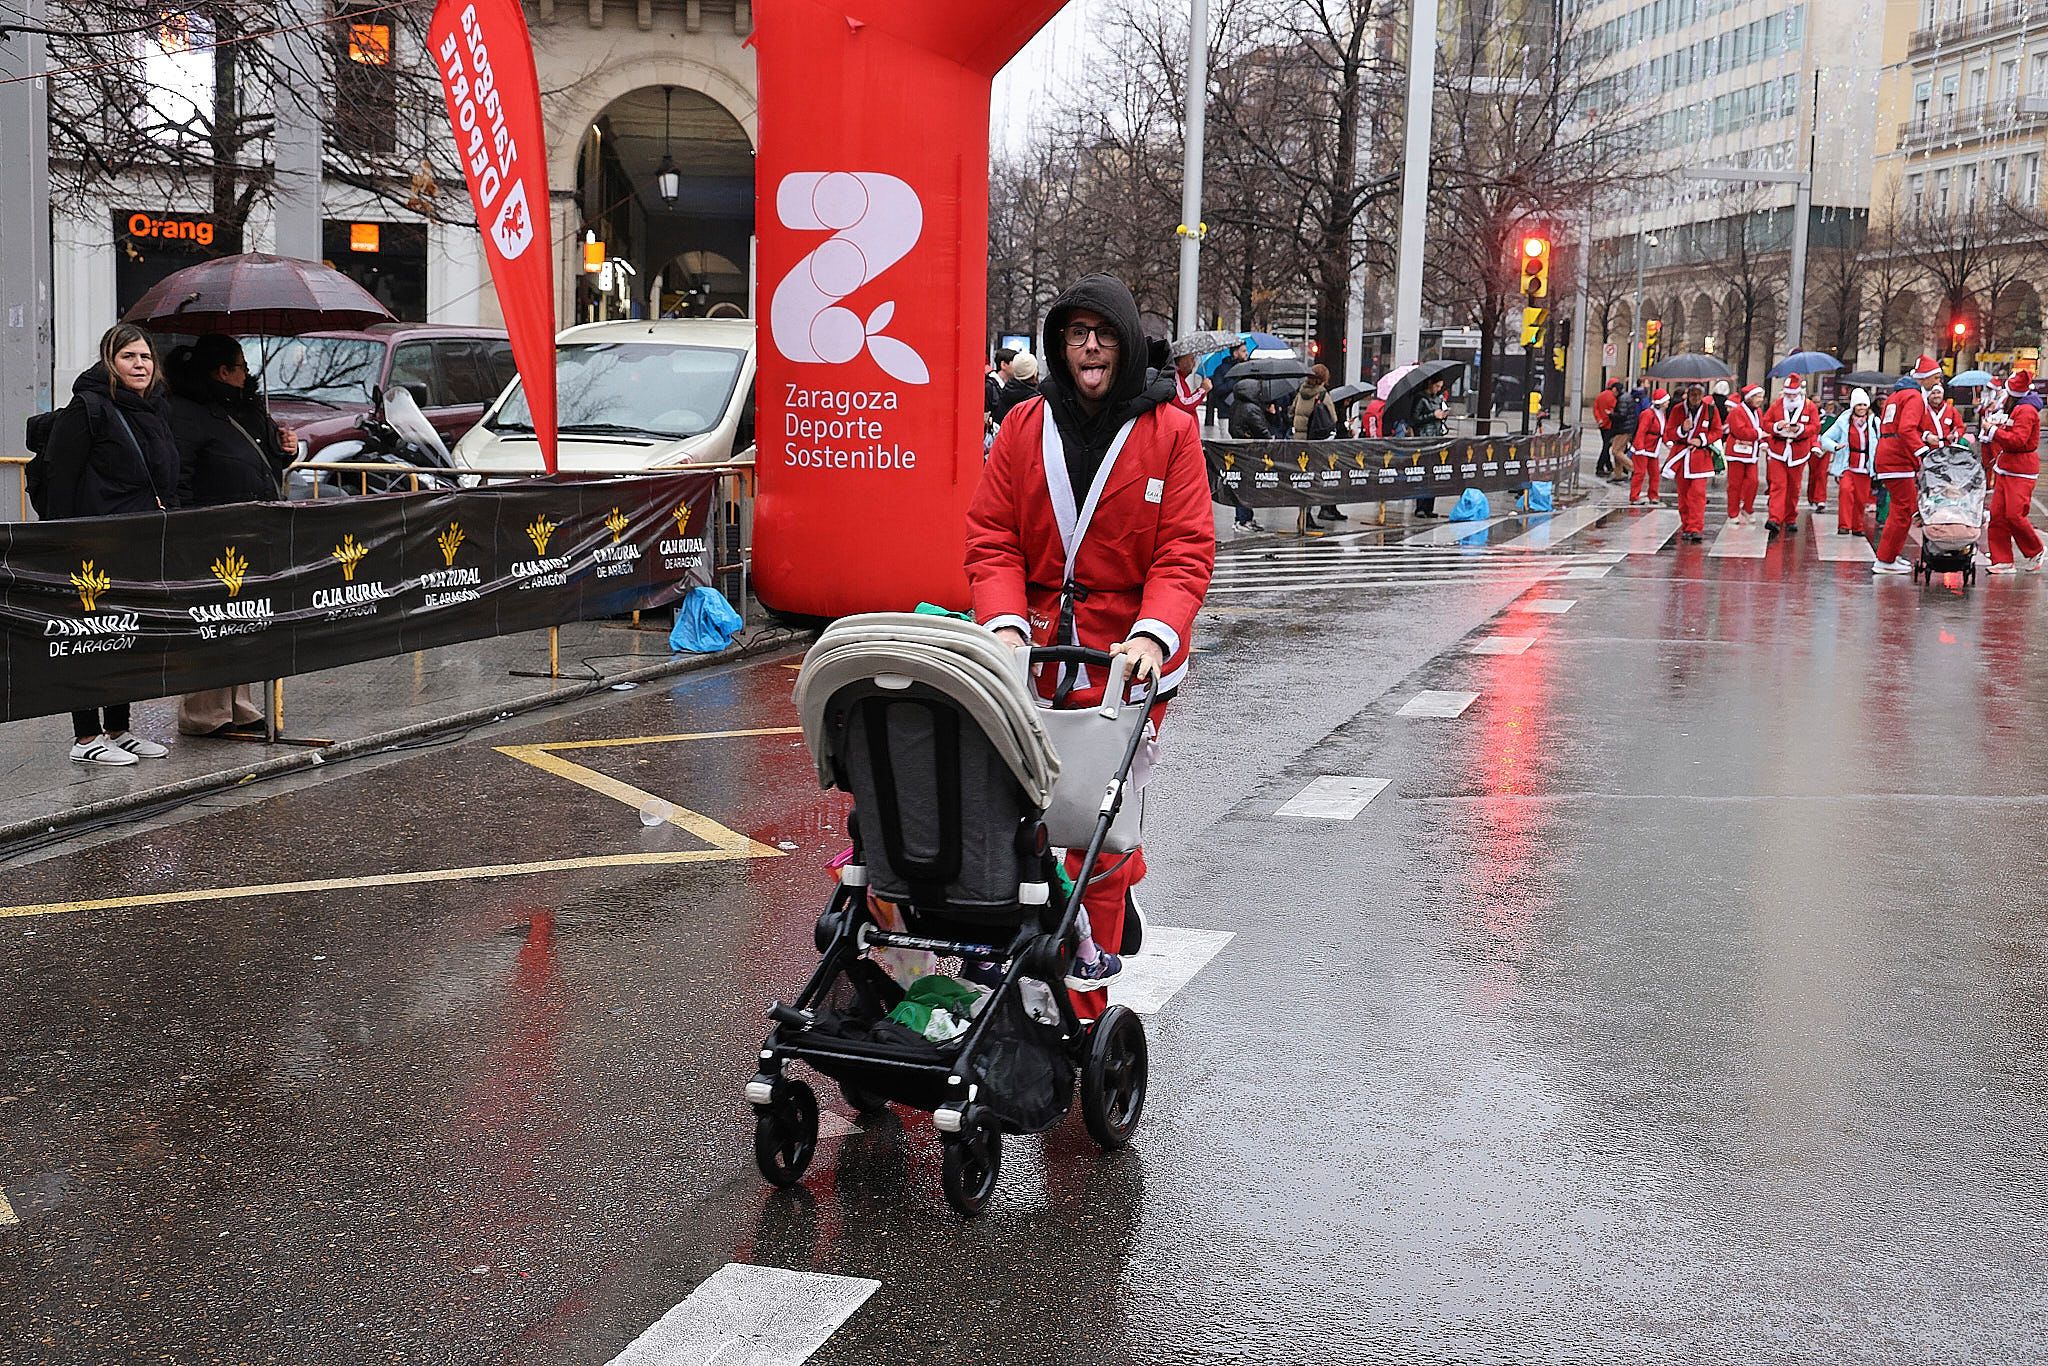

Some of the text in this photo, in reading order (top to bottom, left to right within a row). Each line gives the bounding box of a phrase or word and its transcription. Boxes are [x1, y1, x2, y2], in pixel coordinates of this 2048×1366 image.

[127, 213, 215, 246] Orang
[784, 383, 898, 416] Zaragoza
[784, 412, 883, 444] Deporte
[784, 442, 917, 469] Sostenible
[678, 537, 707, 553] RURAL
[511, 560, 543, 578] CAJA
[664, 554, 703, 570] DE ARAGÓN
[531, 571, 567, 589] ARAGÓN
[312, 581, 390, 609] CAJA RURAL
[425, 587, 481, 607] DE ARAGÓN
[225, 597, 275, 620] RURAL
[83, 612, 140, 636] RURAL
[199, 624, 219, 640] DE
[49, 633, 137, 658] DE ARAGÓN
